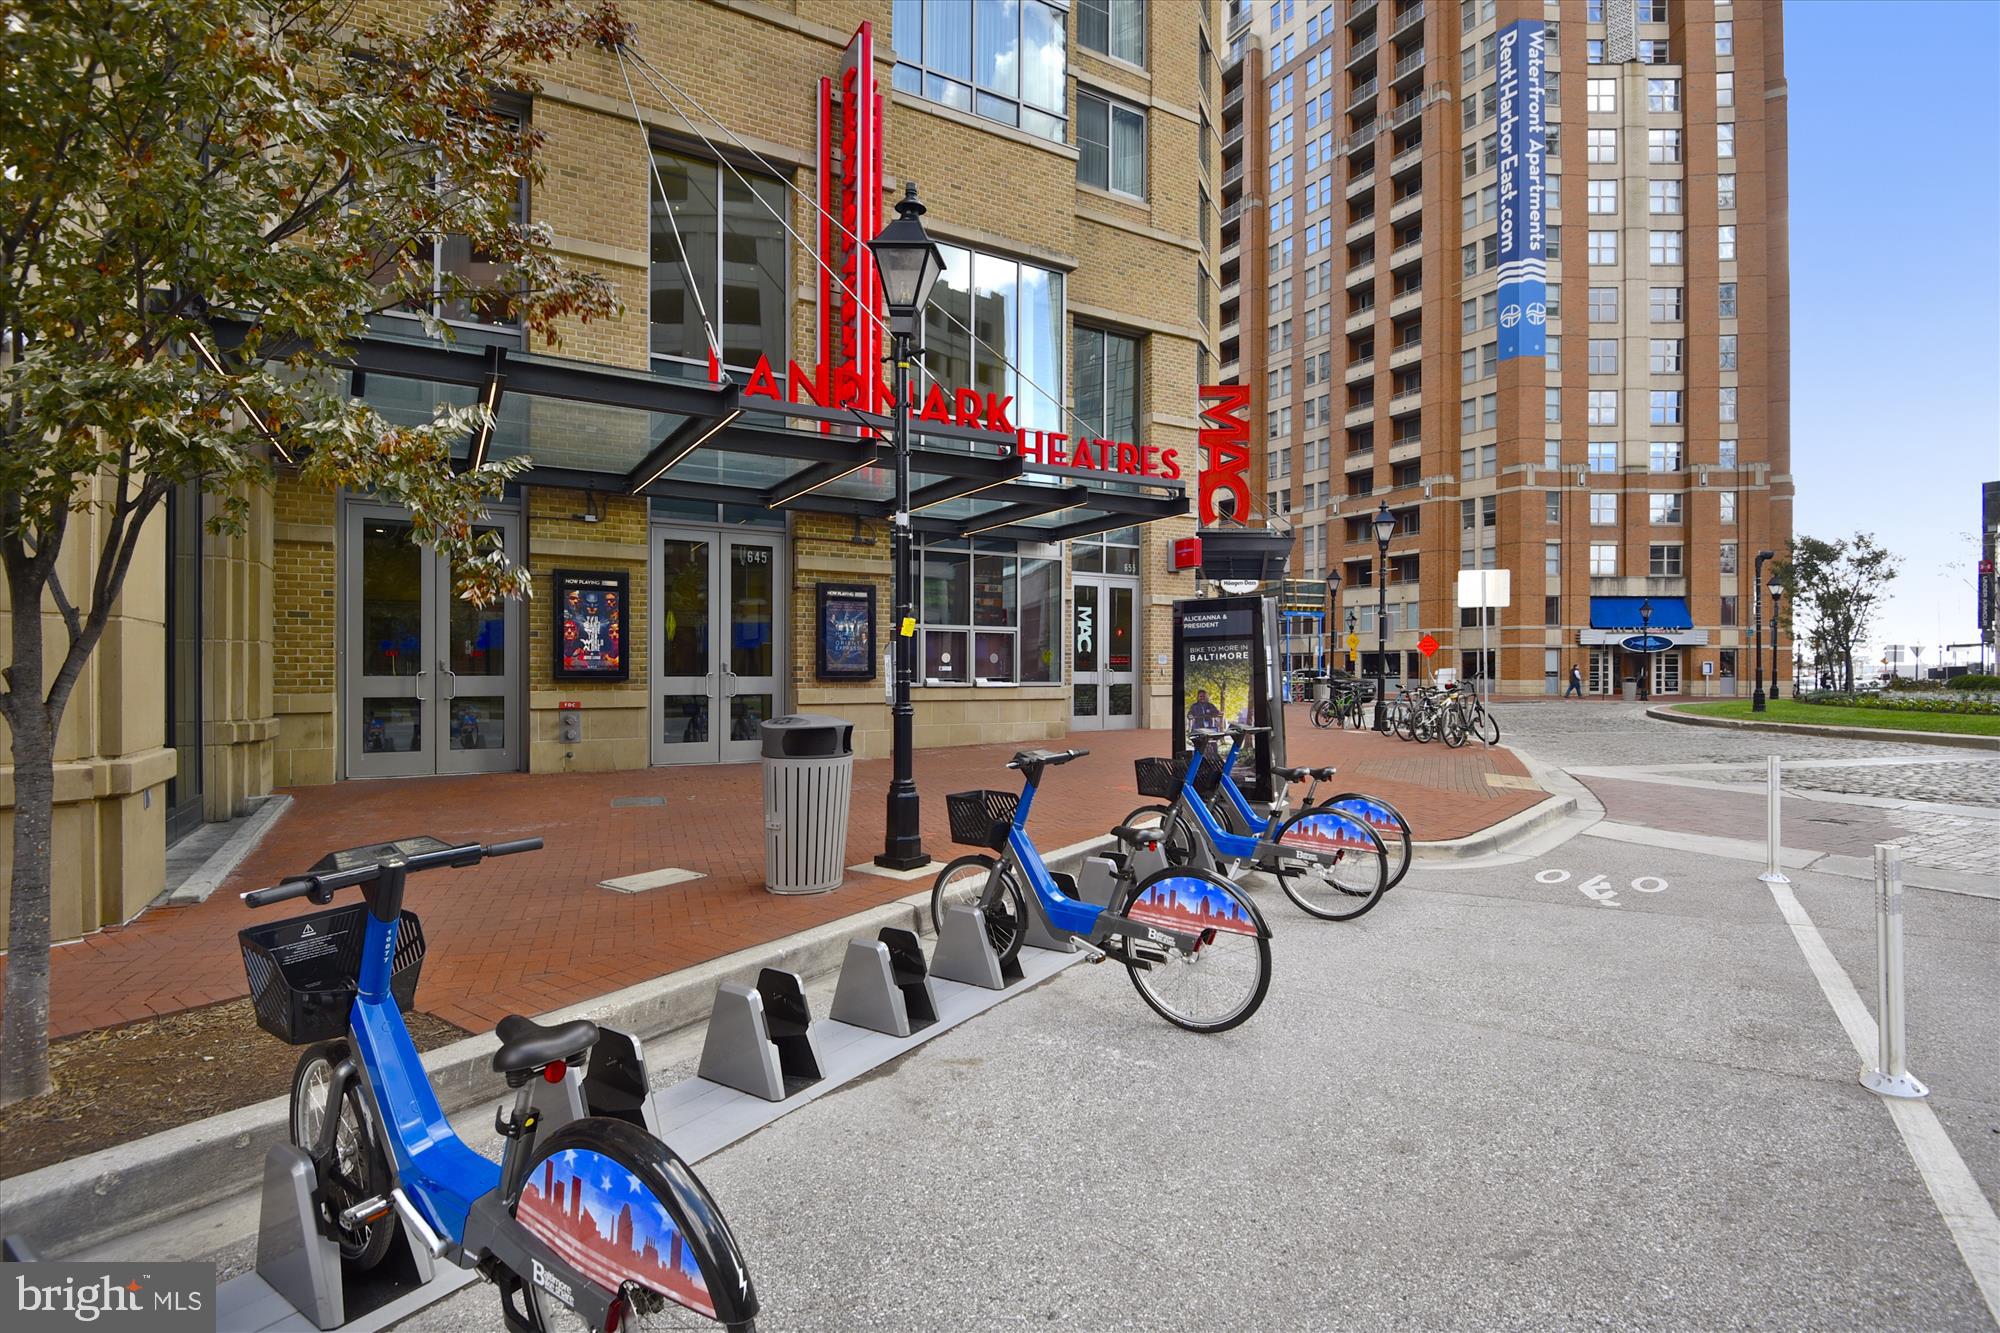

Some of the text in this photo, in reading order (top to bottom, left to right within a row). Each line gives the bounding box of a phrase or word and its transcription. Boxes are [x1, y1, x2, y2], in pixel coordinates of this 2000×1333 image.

[1525, 30, 1545, 251] Waterfront Apartments
[1199, 384, 1250, 527] MAC
[747, 550, 768, 564] 645
[1077, 606, 1092, 653] MAC
[1183, 614, 1221, 622] ALICEANNA
[1183, 621, 1219, 629] PRESIDENT
[1190, 652, 1249, 662] BALTIMORE
[383, 929, 392, 963] 10077
